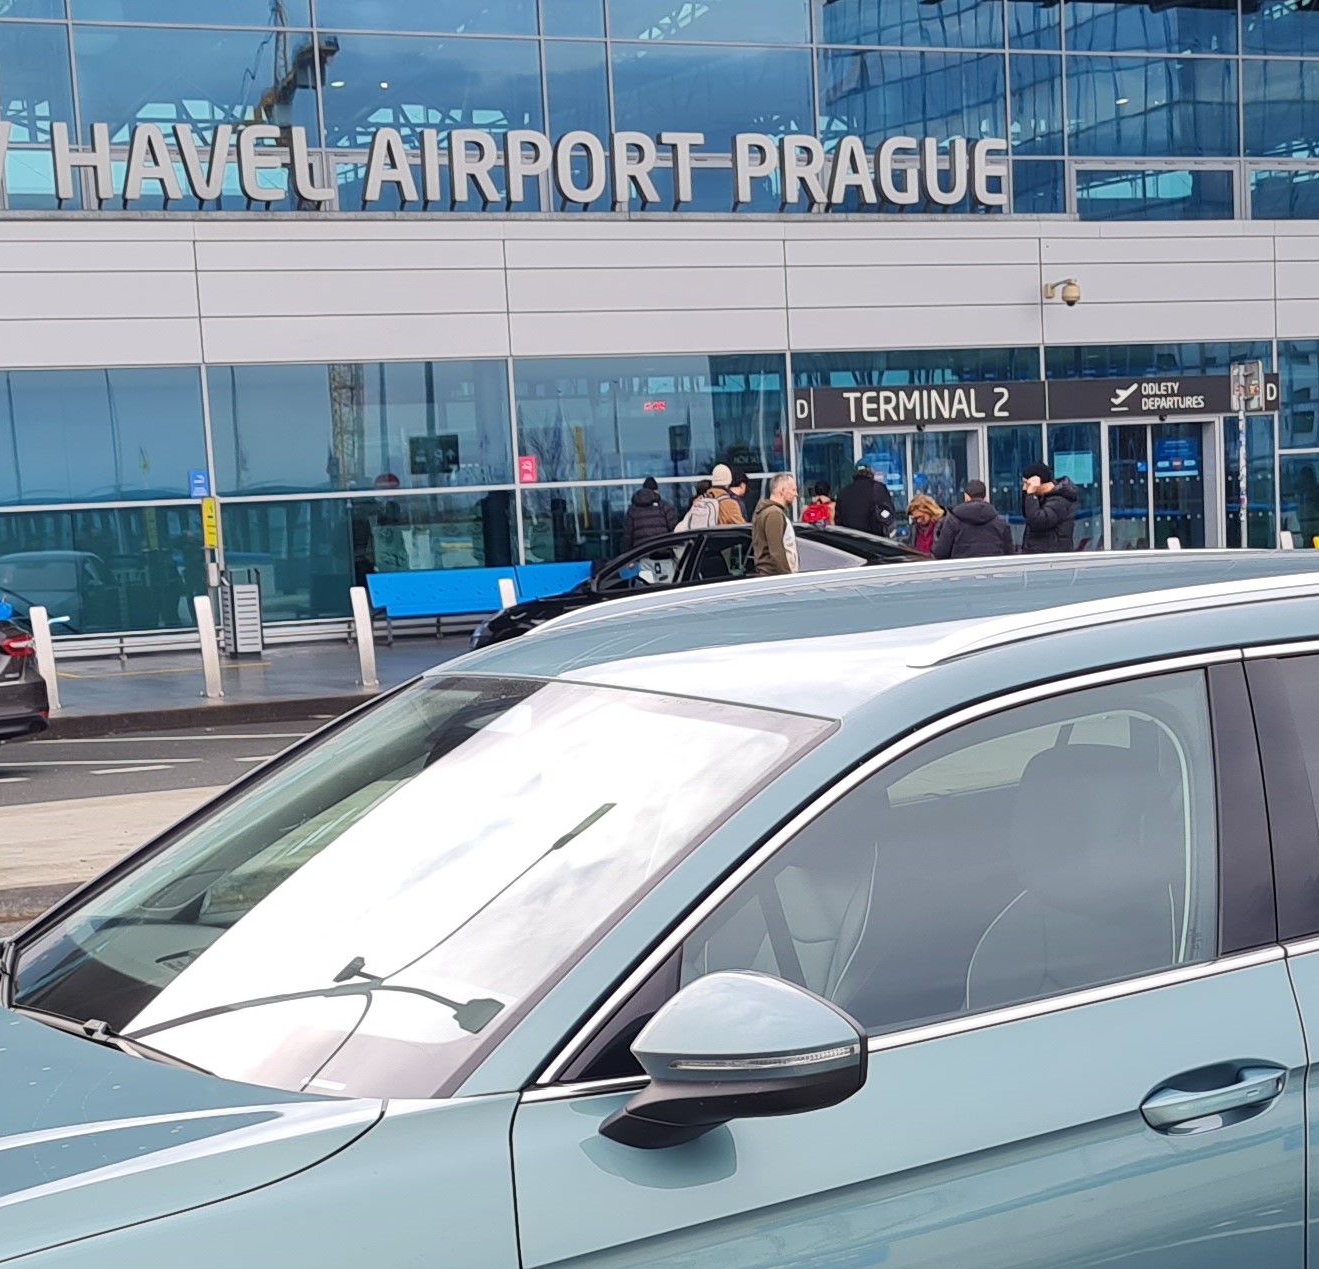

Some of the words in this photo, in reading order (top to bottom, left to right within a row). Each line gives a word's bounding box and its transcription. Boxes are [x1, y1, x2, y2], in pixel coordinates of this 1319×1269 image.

[50, 121, 336, 201] HAVEL
[364, 127, 705, 203] AIRPORT
[732, 133, 1008, 206] PRAGUE
[1141, 381, 1180, 396] ODLETY
[1266, 383, 1278, 402] D
[796, 399, 808, 420] D
[842, 387, 986, 423] TERMINAL
[993, 386, 1010, 417] 2
[1141, 394, 1205, 411] DEPARTURES
